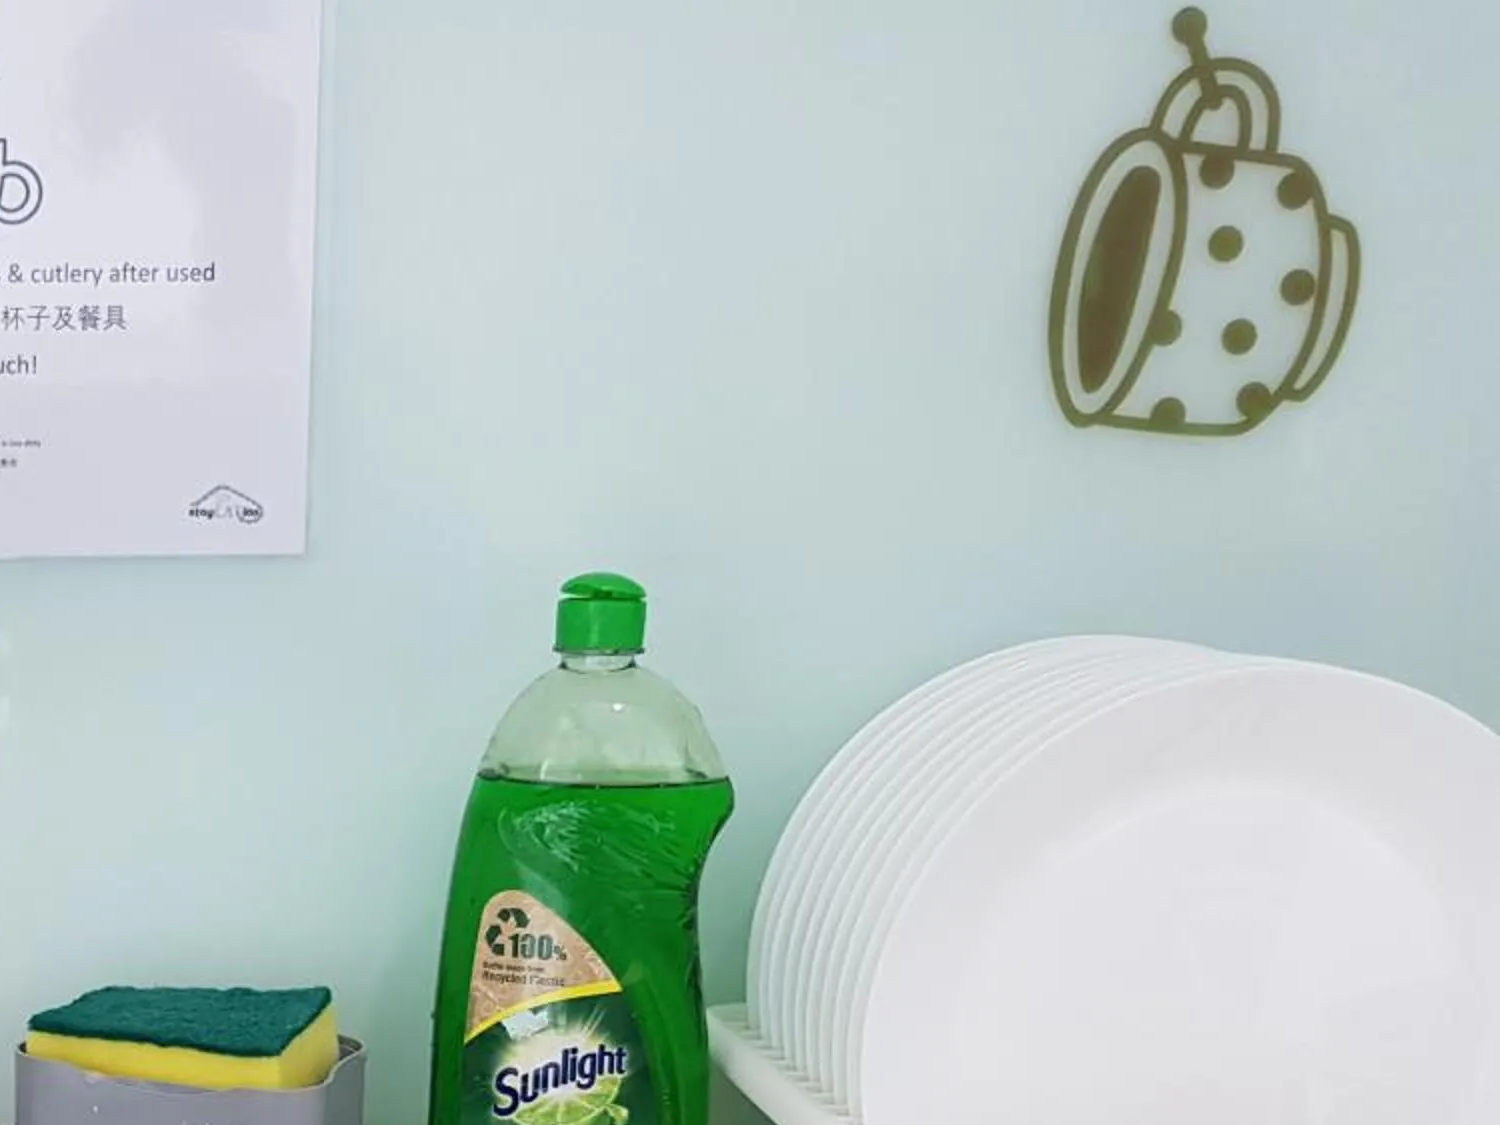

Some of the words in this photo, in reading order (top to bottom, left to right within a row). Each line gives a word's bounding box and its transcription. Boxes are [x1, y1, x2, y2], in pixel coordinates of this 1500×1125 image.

[7, 262, 24, 284] &
[30, 261, 102, 287] cutlery
[108, 261, 159, 284] after
[166, 261, 216, 283] used
[508, 932, 567, 961] 100%
[492, 1044, 627, 1117] Sunlight
